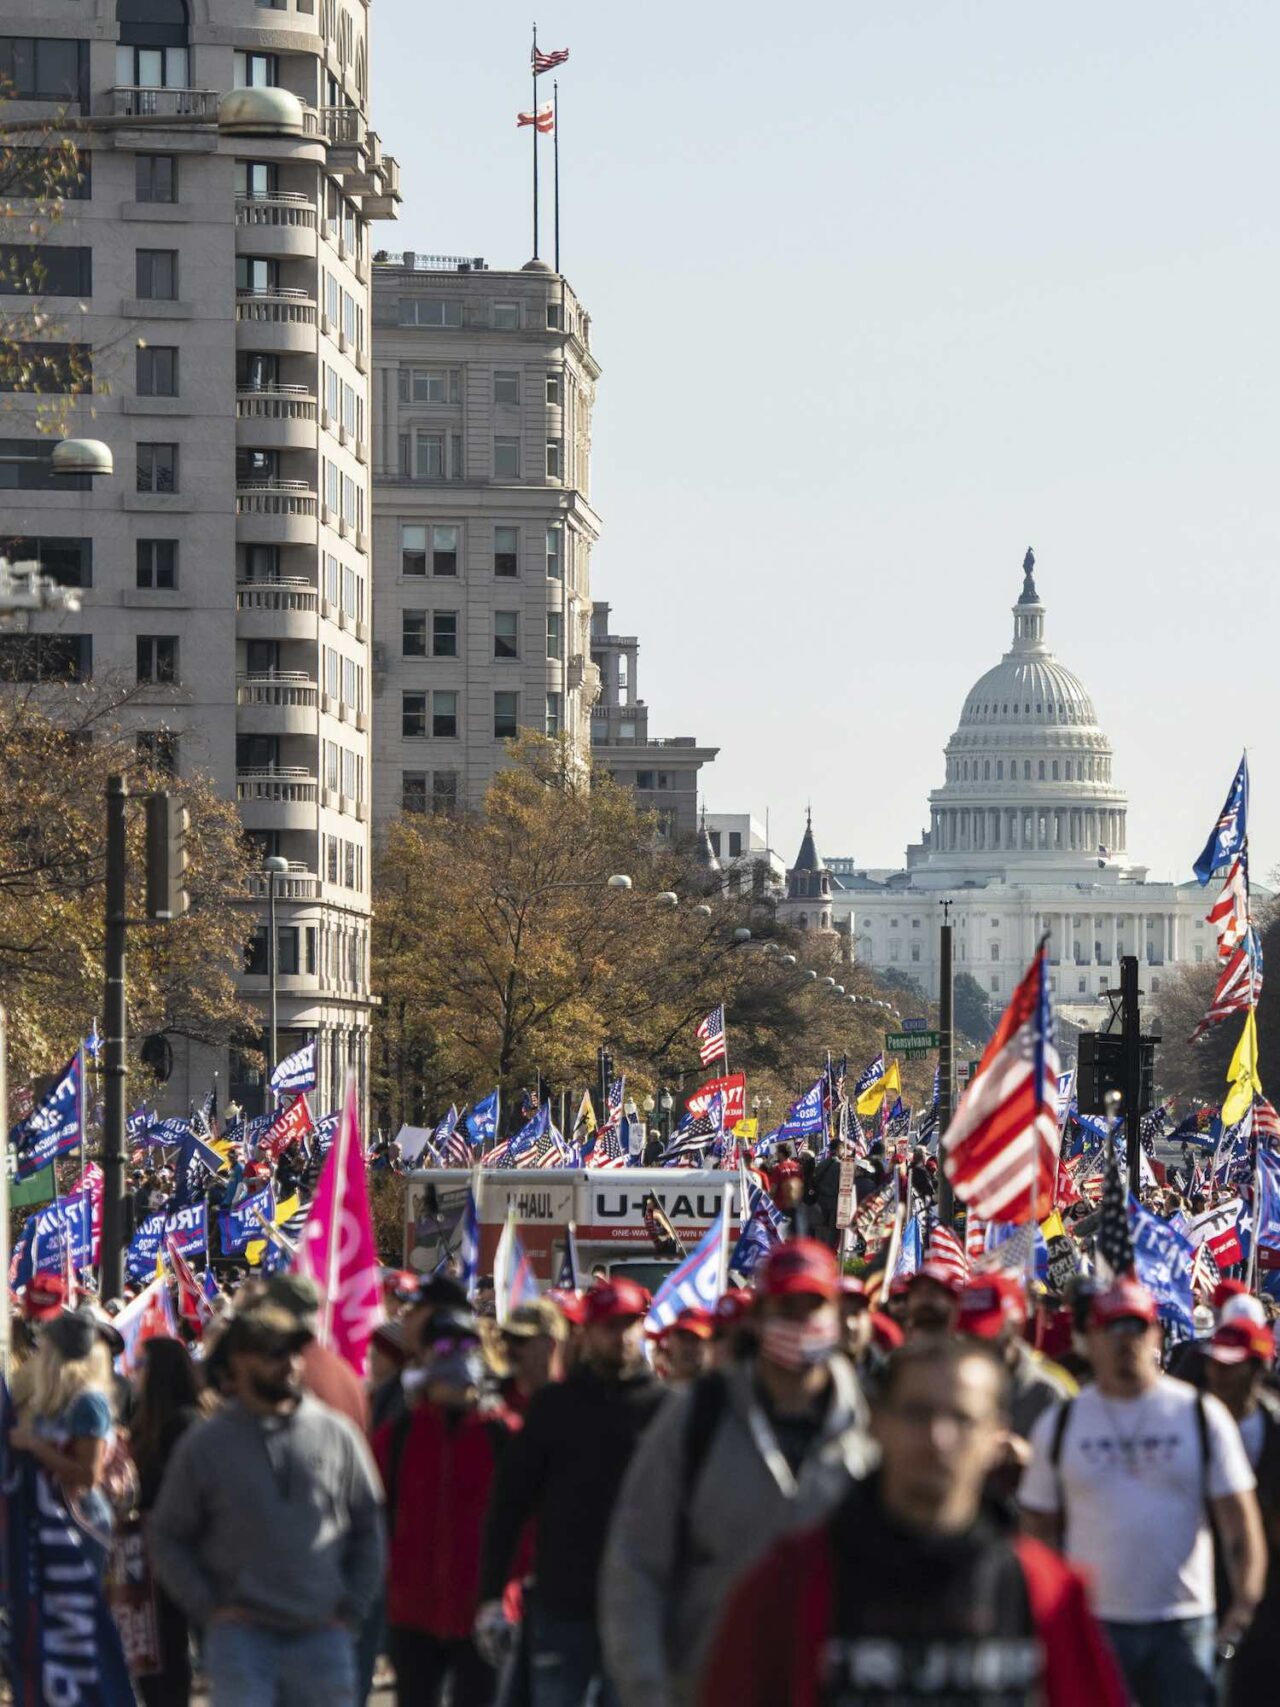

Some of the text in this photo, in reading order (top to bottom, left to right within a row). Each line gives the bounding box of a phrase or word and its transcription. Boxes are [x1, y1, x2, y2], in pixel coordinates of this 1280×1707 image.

[887, 1034, 932, 1049] Pennsylvania
[506, 1192, 553, 1218] U-HAUL
[597, 1194, 741, 1218] U-HAUL
[611, 1228, 649, 1238] ONE-WAY
[1049, 1239, 1070, 1258] EAD
